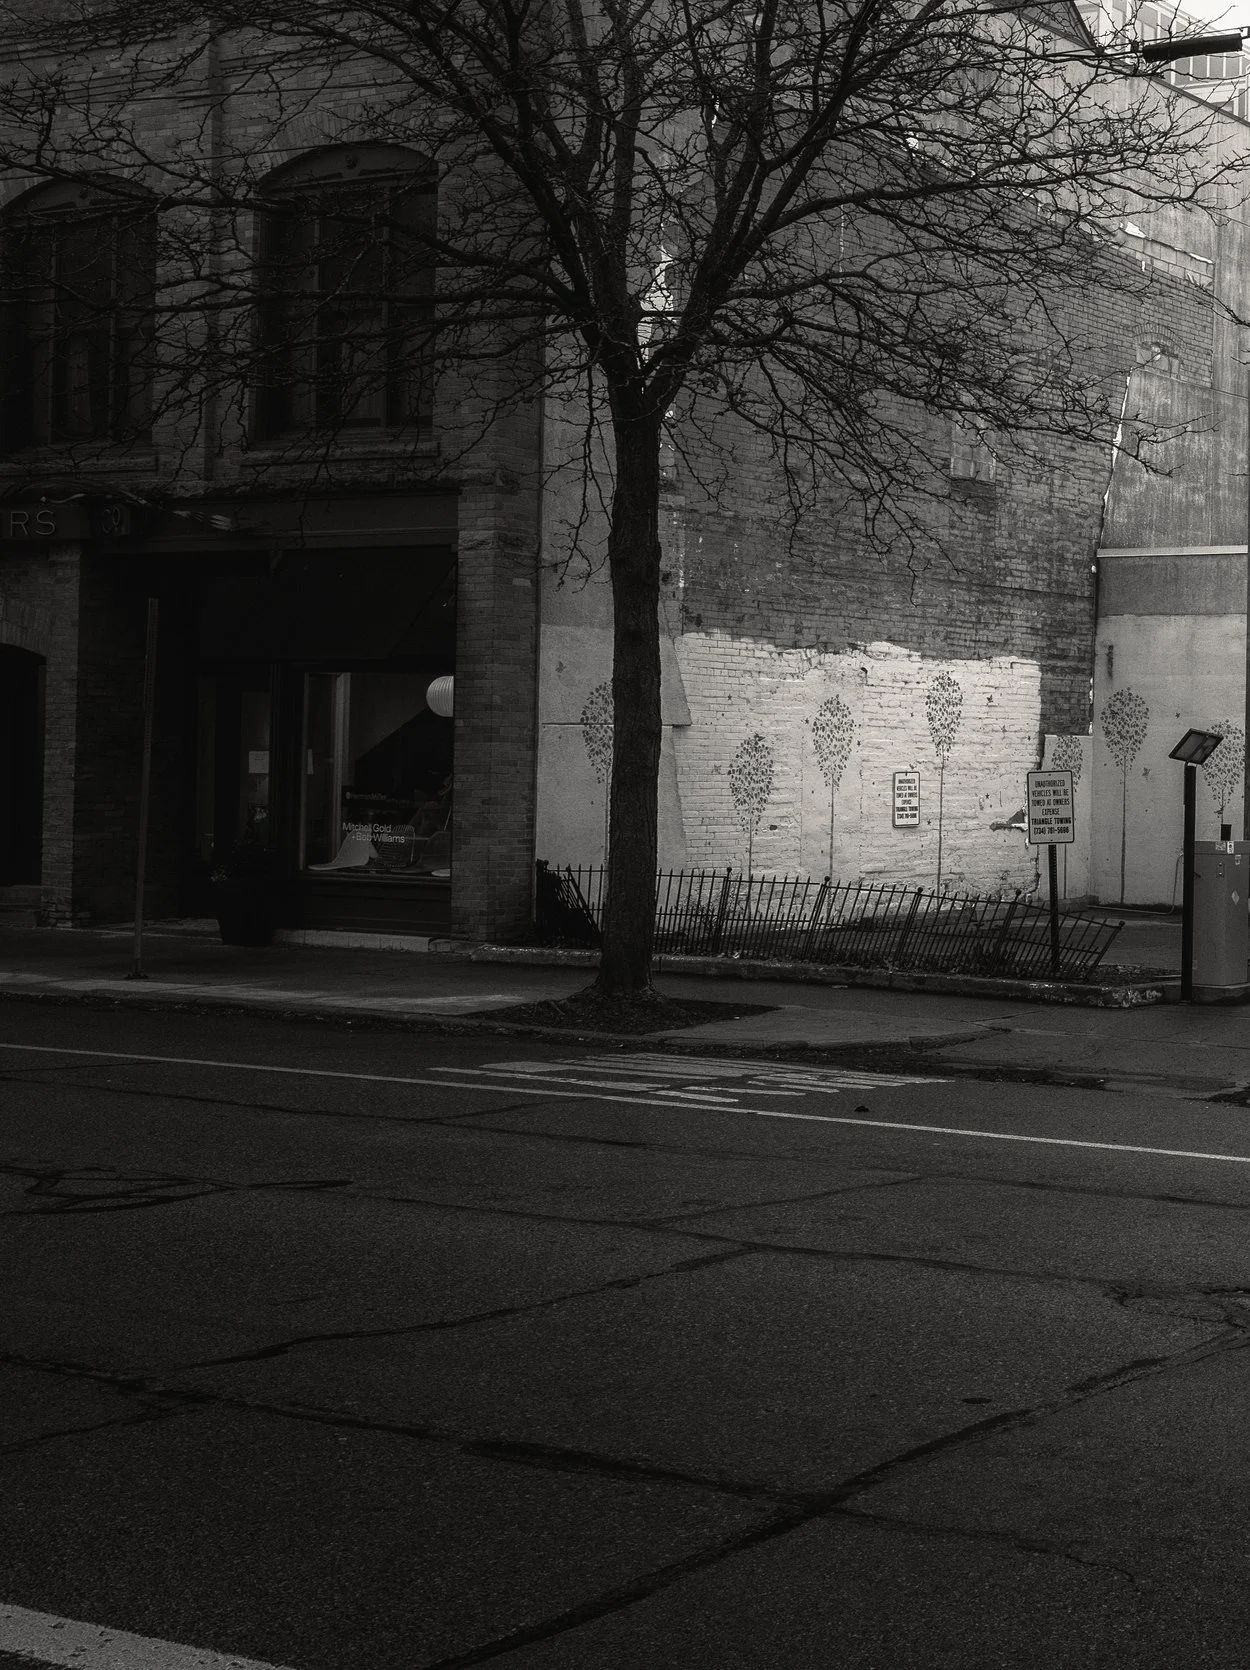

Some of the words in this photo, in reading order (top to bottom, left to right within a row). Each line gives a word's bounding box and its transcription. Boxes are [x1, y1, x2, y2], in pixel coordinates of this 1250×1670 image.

[1034, 779, 1066, 788] UNAUTHORIZED
[1032, 790, 1052, 798] VEHICLES
[1052, 789, 1062, 797] WILL
[1063, 788, 1069, 797] BE
[1031, 799, 1045, 807] TOWED
[1046, 798, 1052, 806] AT
[1041, 808, 1060, 816] EXPENSE
[1031, 818, 1053, 826] TRIANGLE
[1054, 817, 1072, 825] TOWING
[373, 823, 391, 833] Gold
